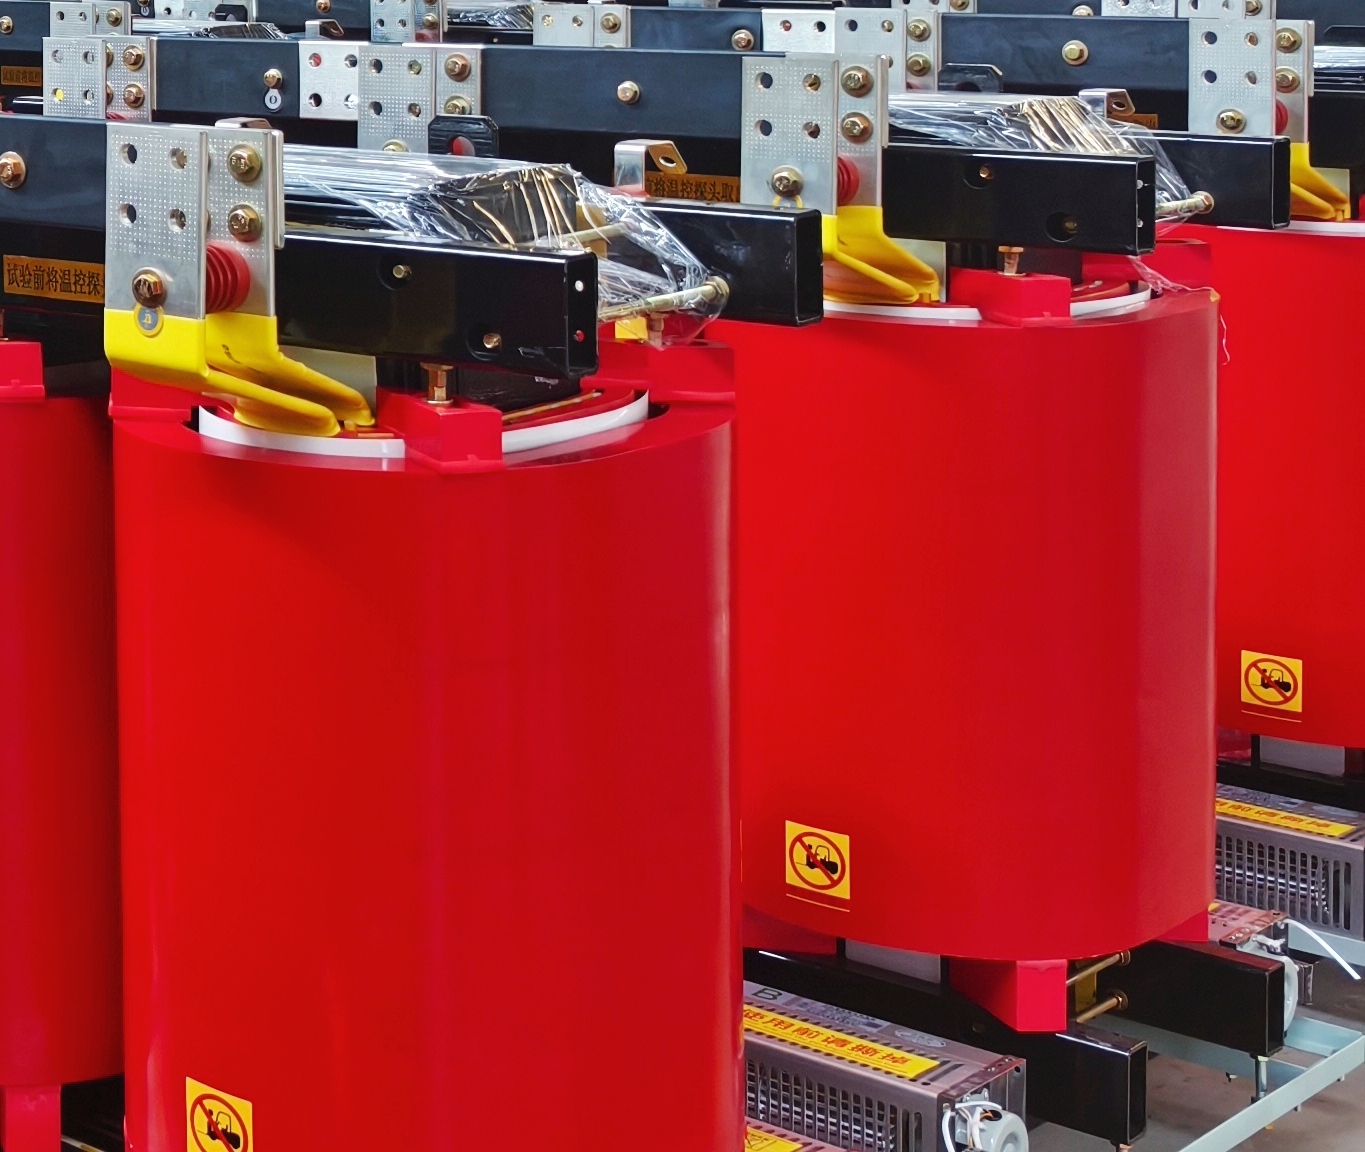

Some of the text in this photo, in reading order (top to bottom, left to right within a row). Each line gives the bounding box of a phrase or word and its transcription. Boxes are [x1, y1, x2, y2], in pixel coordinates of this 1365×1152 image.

[645, 177, 741, 202] 将温控探头取
[6, 263, 105, 296] 试验前将温控探
[751, 987, 783, 1001] B
